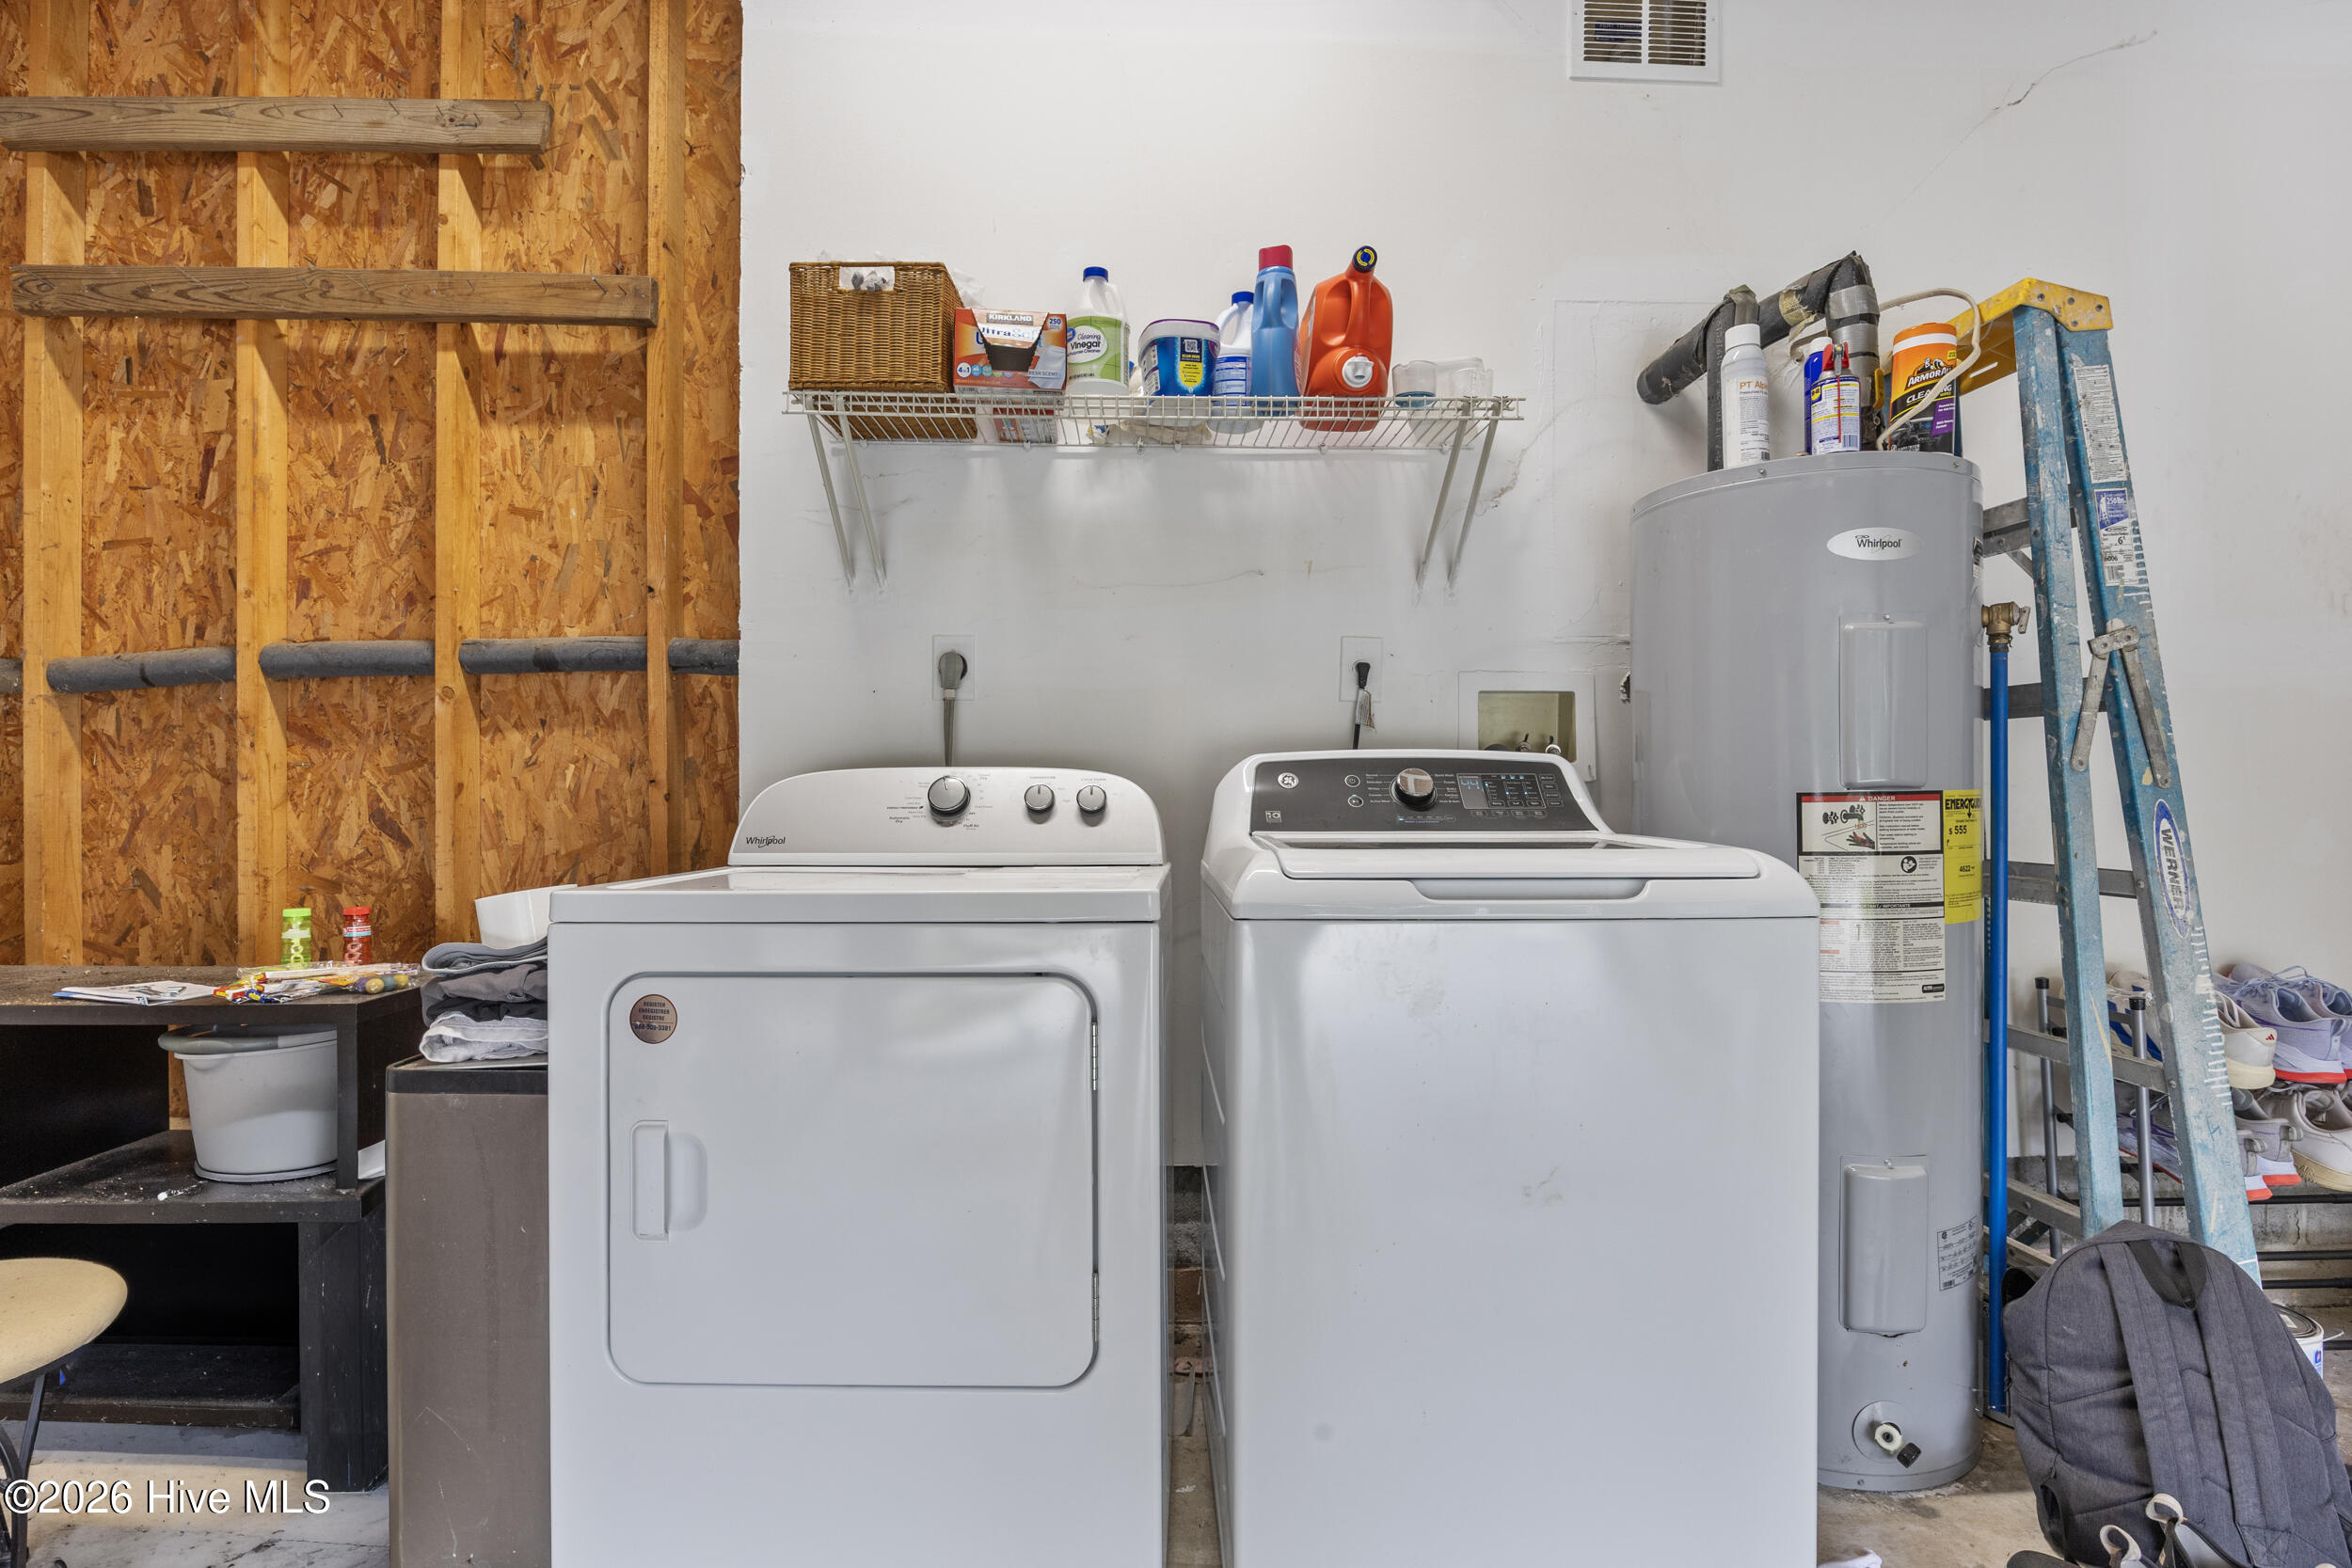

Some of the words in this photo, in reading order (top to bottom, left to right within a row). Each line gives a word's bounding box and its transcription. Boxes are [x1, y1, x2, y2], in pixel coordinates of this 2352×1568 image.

[988, 313, 1033, 322] KIRKLAND
[1071, 341, 1101, 350] Vinegar
[1740, 381, 1753, 390] PT
[1906, 384, 1952, 404] CLEANG
[1856, 538, 1901, 549] Whirlpool
[1954, 825, 1967, 834] 555
[746, 836, 786, 847] Whirlpool
[2161, 828, 2185, 911] WERNER
